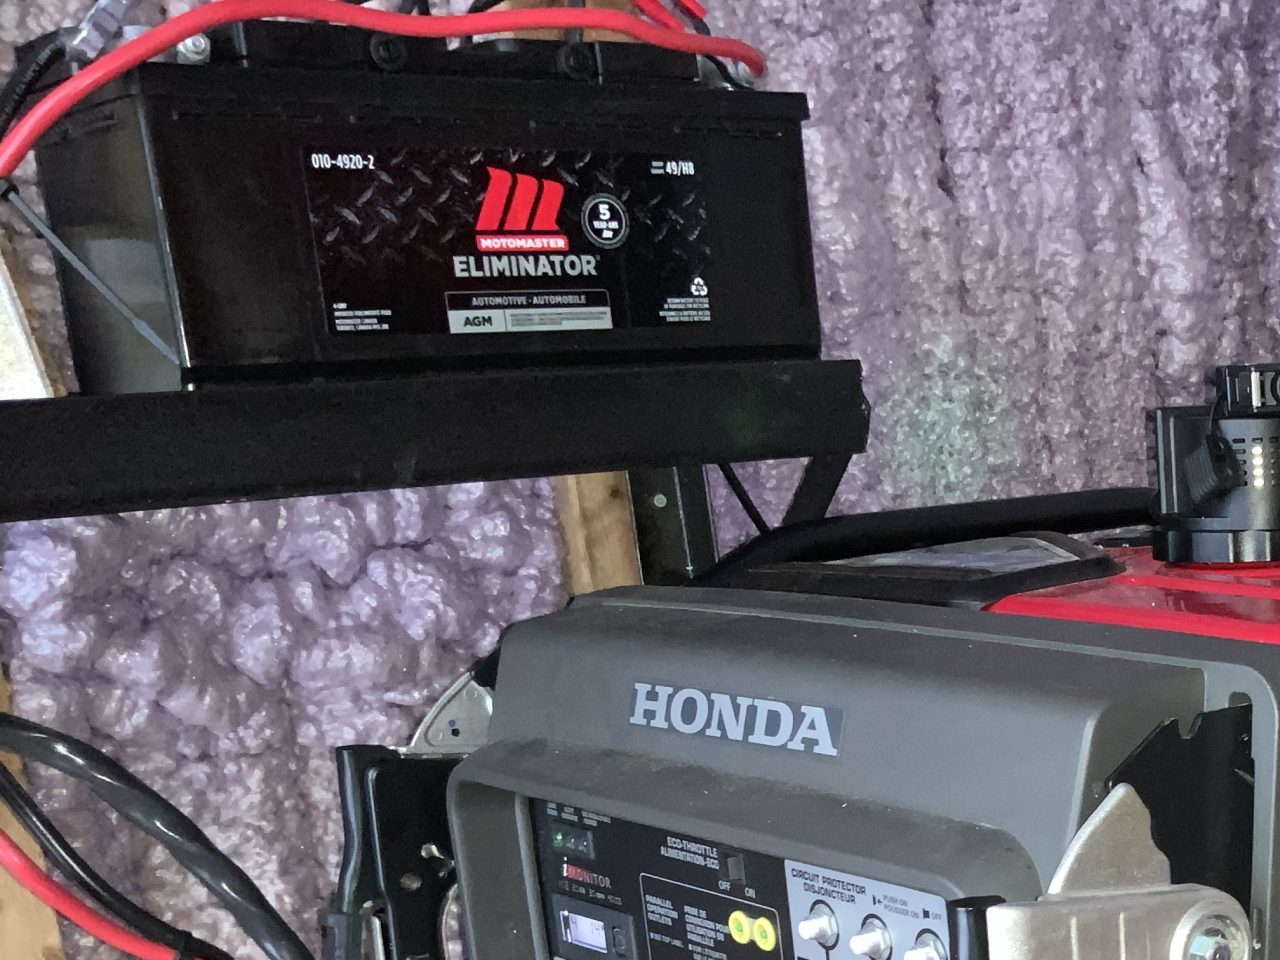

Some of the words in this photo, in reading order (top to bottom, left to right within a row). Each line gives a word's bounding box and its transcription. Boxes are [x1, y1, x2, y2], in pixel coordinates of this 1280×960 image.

[311, 153, 375, 170] 010-4920-2
[665, 160, 695, 176] 49/H8
[599, 203, 611, 220] 5
[480, 237, 566, 249] MOTOMASTER
[452, 254, 598, 278] ELIMINATOR
[472, 296, 527, 306] AUTOMOTIVE
[533, 294, 587, 305] AUTOMOBILE
[463, 315, 493, 327] AGM
[629, 682, 838, 757] HONDA
[666, 836, 718, 858] ECO-THROTTLE
[718, 880, 731, 891] OFF
[791, 868, 820, 883] CIRCUIT
[822, 875, 867, 895] PROTECTOR
[744, 887, 756, 898] ON
[803, 882, 856, 904] DISJONCTEUR
